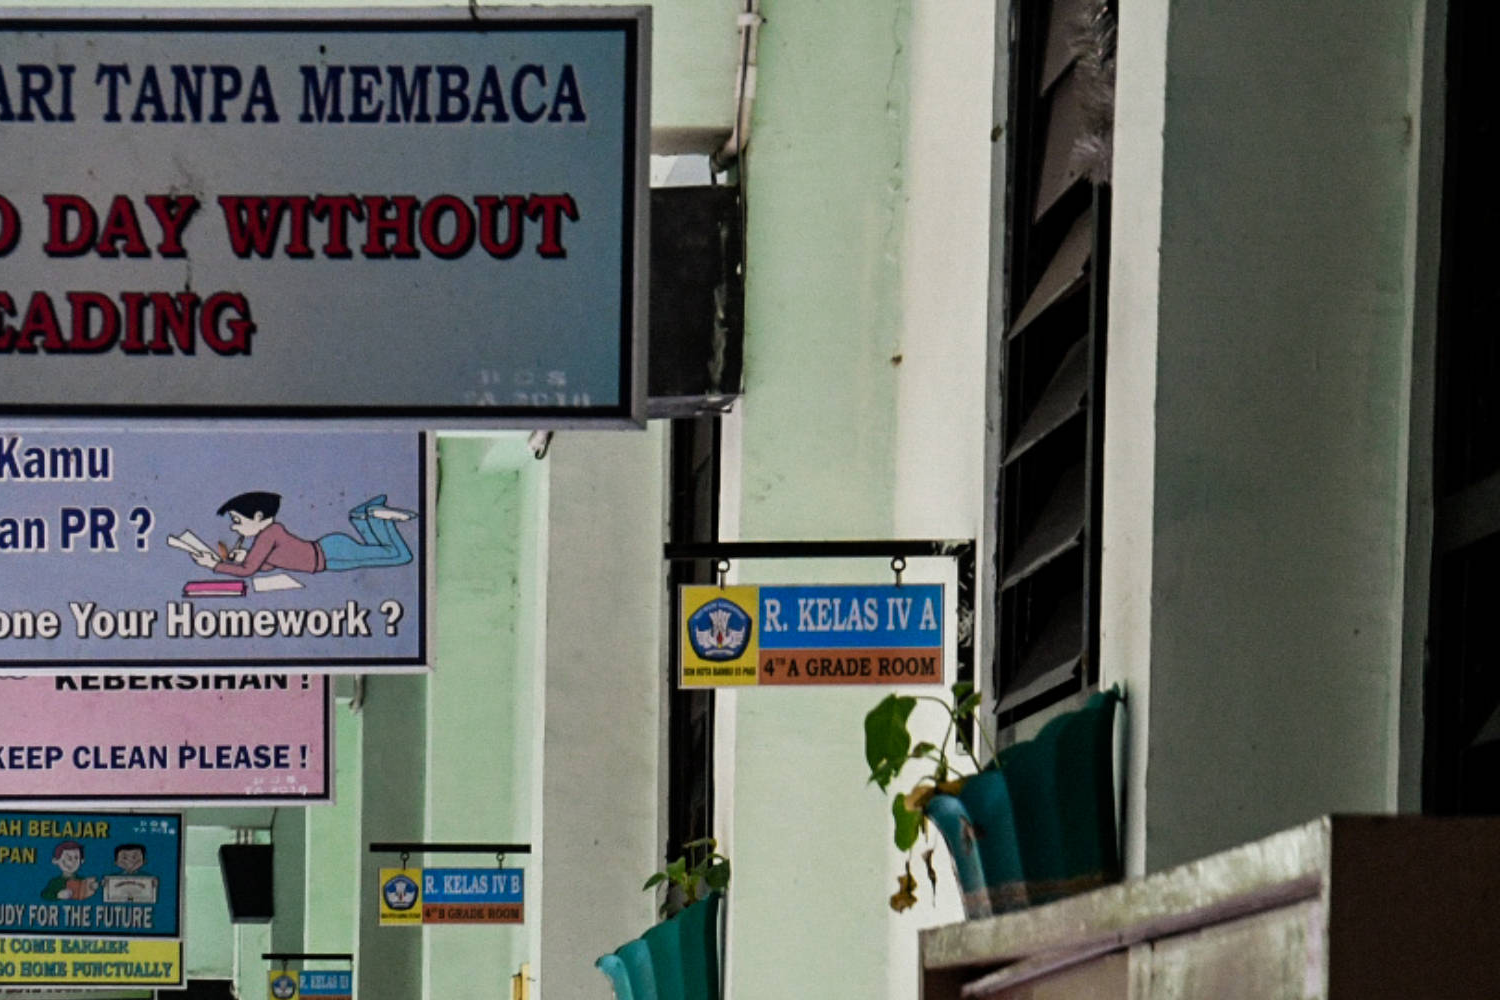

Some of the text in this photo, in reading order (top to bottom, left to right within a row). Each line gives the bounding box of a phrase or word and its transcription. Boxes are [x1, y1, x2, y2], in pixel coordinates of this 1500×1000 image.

[95, 62, 280, 123] TANPA
[299, 64, 587, 123] MEMBACA
[43, 194, 199, 258] DAY
[218, 192, 579, 259] WITHOUT
[60, 507, 116, 551] PR
[129, 506, 153, 551] ?
[70, 601, 157, 638] Your
[166, 600, 370, 638] Homework
[380, 599, 404, 636] ?
[764, 599, 788, 632] R.
[798, 598, 878, 632] KELAS
[887, 598, 912, 631] IV
[920, 598, 937, 630] A
[806, 658, 871, 677] GRADE
[878, 657, 936, 676] ROOM
[55, 674, 288, 690] KEBERSIHAN
[72, 745, 168, 769] CLEAN
[178, 744, 291, 769] PLEASE
[300, 745, 307, 769] !
[28, 819, 109, 838] BELAJAR
[425, 875, 439, 894] R.
[444, 874, 488, 894] KELAS
[492, 874, 508, 894] IV
[28, 904, 59, 927] FOR
[62, 905, 92, 927] THE
[95, 906, 153, 928] FUTURE
[10, 938, 56, 953] COME
[61, 939, 129, 954] EARLIER
[20, 962, 67, 977] HOME
[72, 962, 173, 978] PUNCTUALLY
